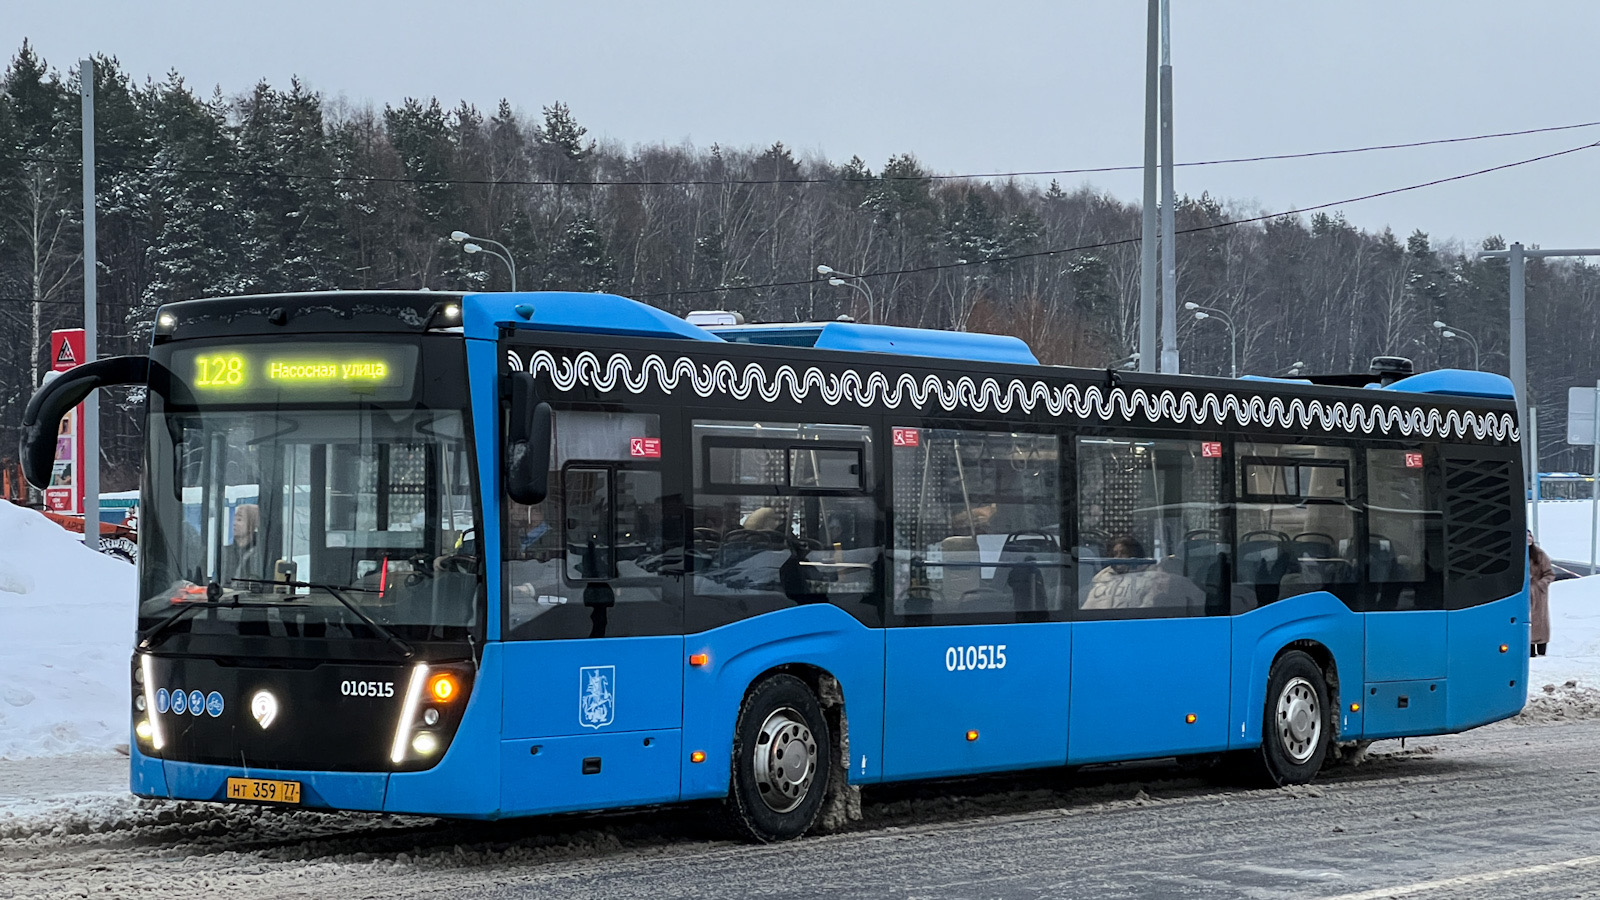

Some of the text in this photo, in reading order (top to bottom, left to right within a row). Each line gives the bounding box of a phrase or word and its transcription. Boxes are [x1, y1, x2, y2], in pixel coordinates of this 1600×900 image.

[197, 356, 385, 386] 128 Насосная улица
[946, 645, 1006, 671] 010515
[341, 680, 394, 697] 010515
[253, 782, 276, 798] 359
[284, 783, 295, 796] 77
